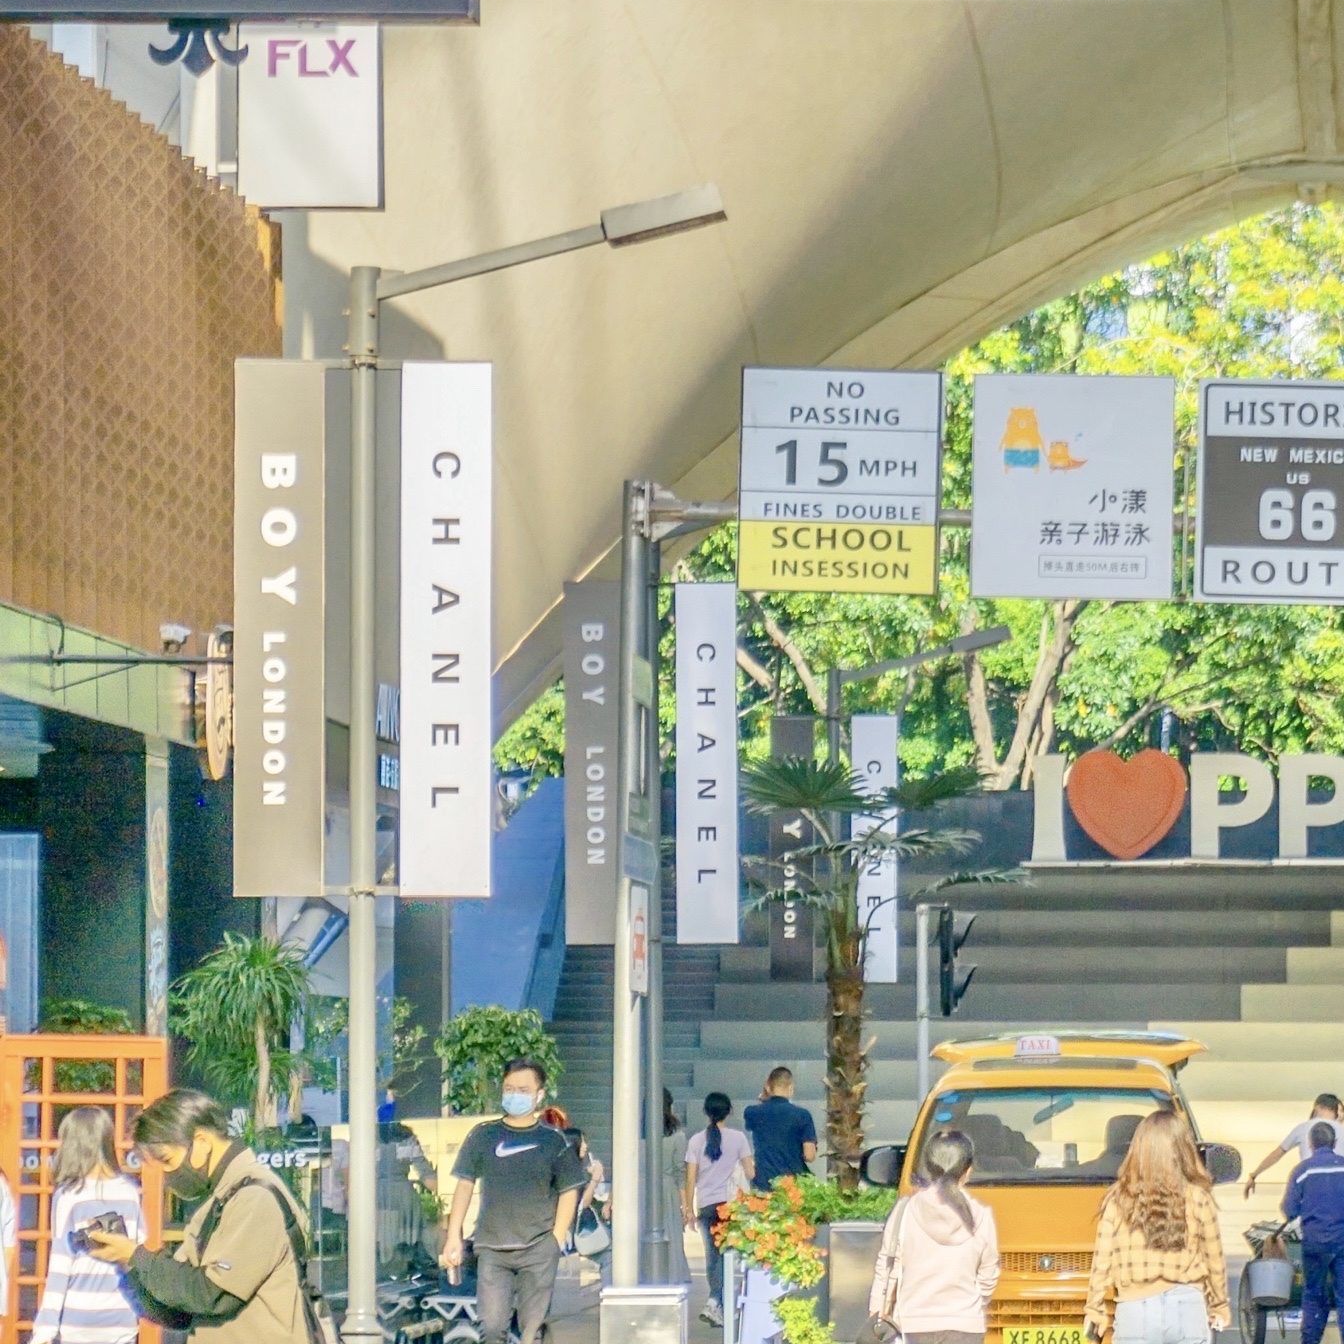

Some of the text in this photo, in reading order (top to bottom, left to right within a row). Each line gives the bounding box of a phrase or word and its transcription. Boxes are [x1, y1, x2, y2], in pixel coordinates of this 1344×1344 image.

[268, 40, 358, 78] FLX
[826, 381, 864, 399] NO
[789, 405, 900, 427] PASSING
[775, 439, 917, 486] 15 MPH
[1240, 448, 1278, 463] NEW
[1287, 473, 1310, 483] US
[763, 502, 921, 521] FINES DOUBLE
[1258, 490, 1337, 541] 66
[261, 452, 297, 605] BOY
[771, 526, 912, 552] SCHOOL
[1039, 521, 1151, 546] 亲子游泳
[772, 558, 909, 580] INSESSION
[431, 451, 461, 808] CHANEL
[581, 624, 605, 705] BOY
[262, 632, 286, 805] LONDON
[696, 643, 717, 884] CHANEL
[586, 746, 606, 865] LONDON
[1019, 1040, 1051, 1050] TAXI
